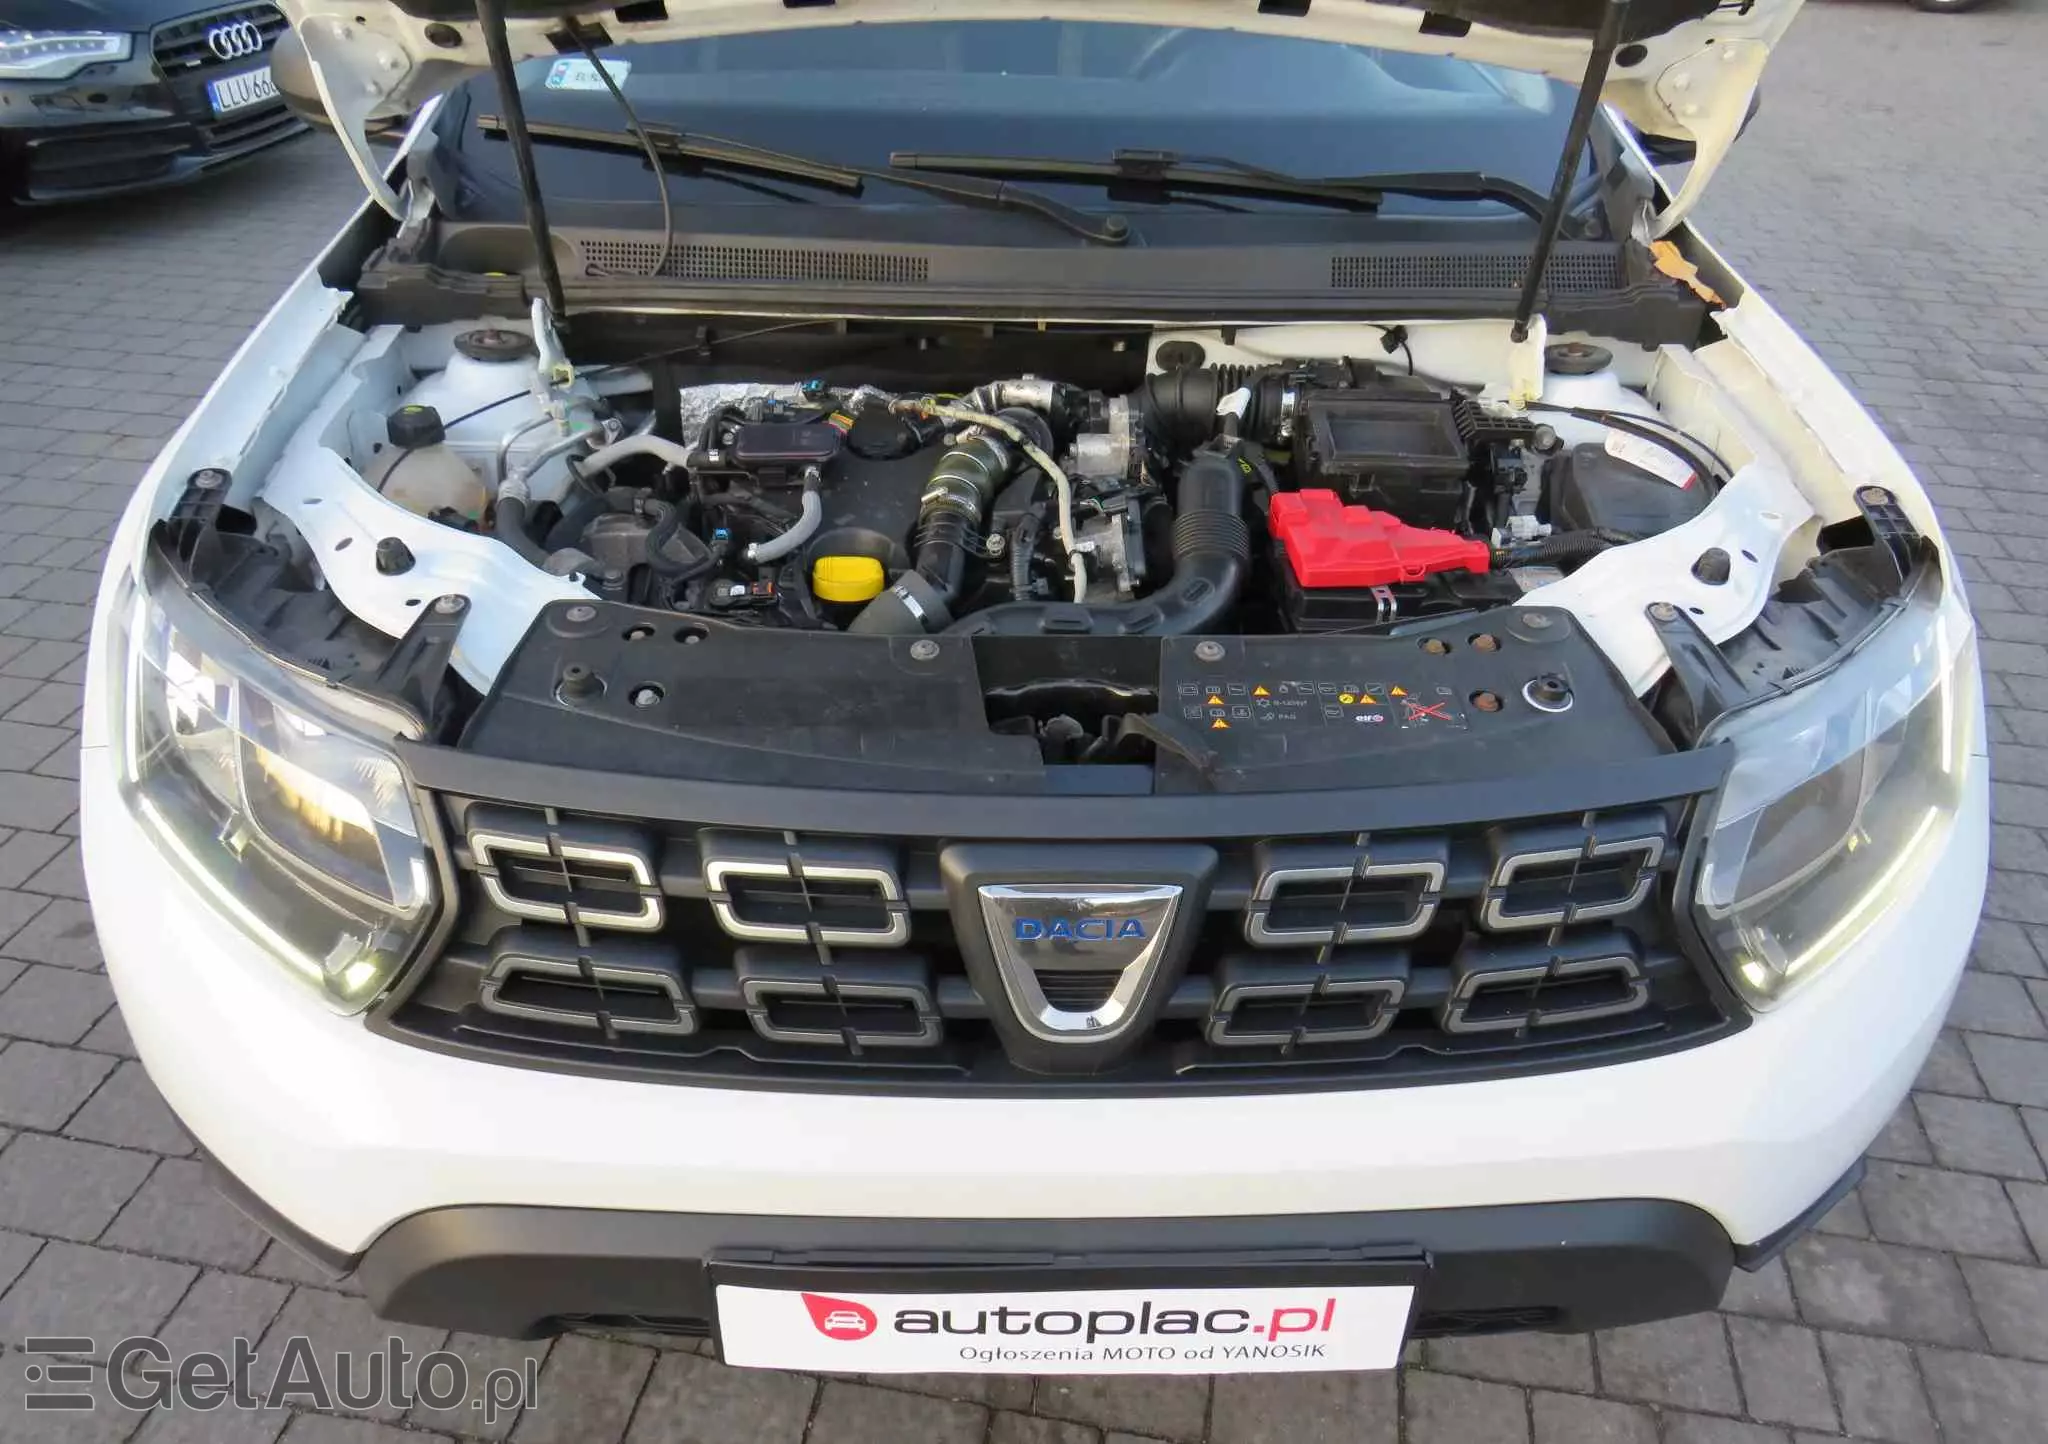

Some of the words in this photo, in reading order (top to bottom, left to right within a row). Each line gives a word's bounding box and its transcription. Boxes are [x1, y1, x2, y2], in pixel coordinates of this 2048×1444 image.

[216, 77, 249, 108] LLU
[1014, 917, 1146, 941] DACIA
[894, 1298, 1336, 1343] autoplac.pl
[959, 1346, 1093, 1362] Ogłoszenia
[1103, 1346, 1176, 1361] MOTO
[1184, 1346, 1214, 1360] od
[1222, 1343, 1326, 1360] YANOSIK
